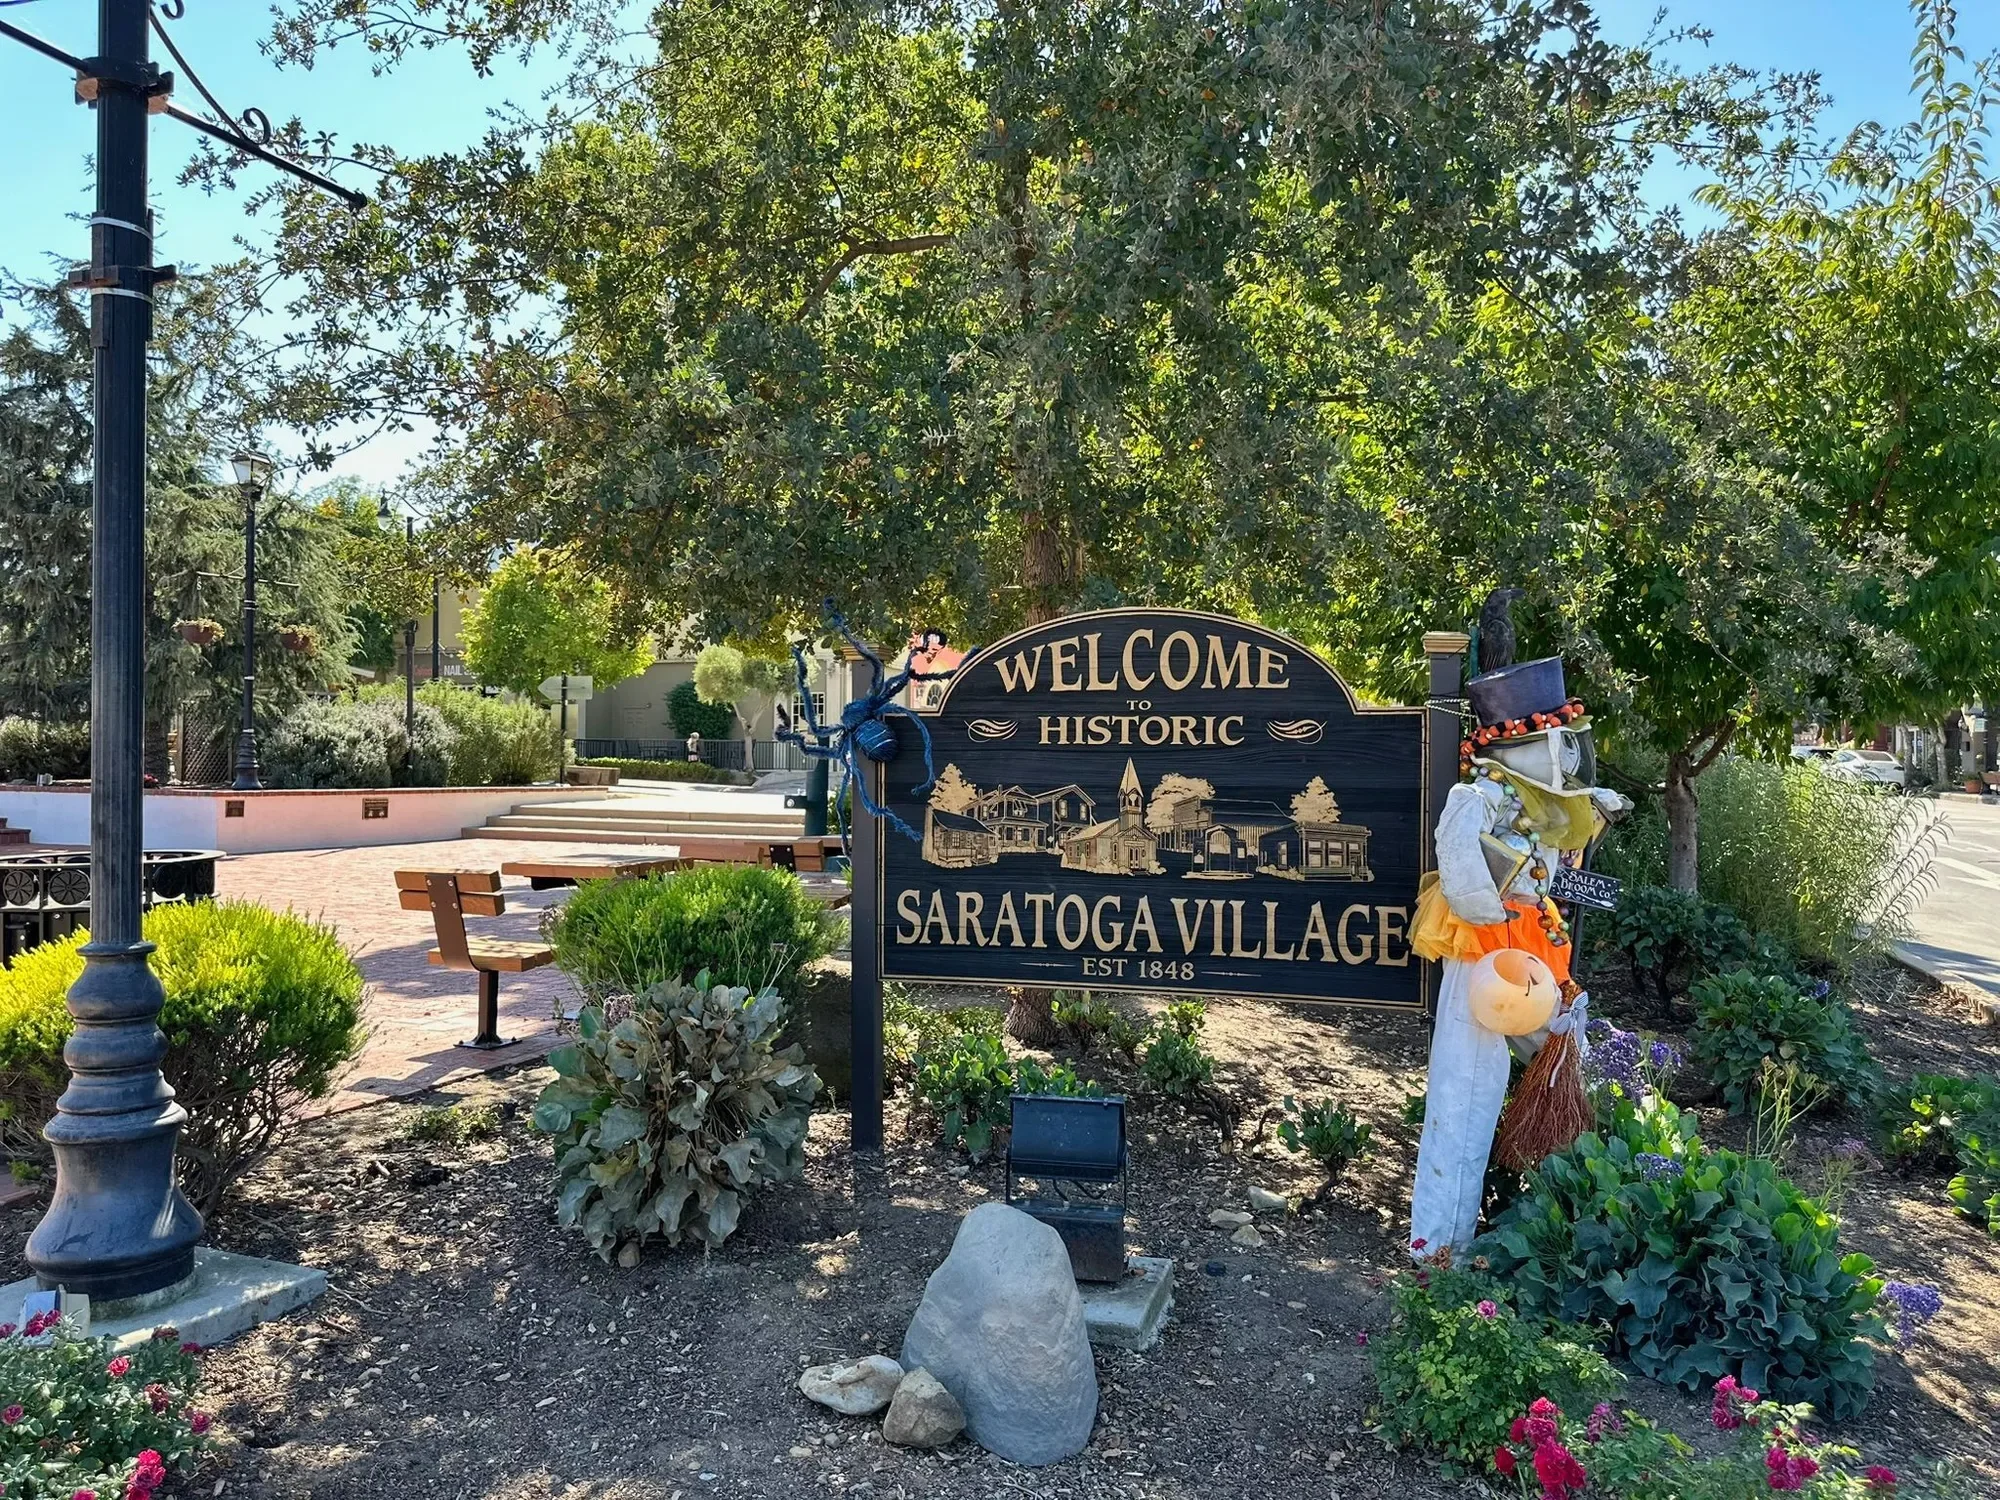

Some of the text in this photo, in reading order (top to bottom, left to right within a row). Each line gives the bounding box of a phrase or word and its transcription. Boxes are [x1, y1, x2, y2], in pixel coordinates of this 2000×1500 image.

[443, 664, 463, 676] NAIL
[993, 629, 1290, 693] WELCOME
[1126, 699, 1152, 711] TO
[1038, 715, 1245, 746] HISTORIC
[1560, 877, 1597, 897] BROOM
[1568, 870, 1606, 889] SALEM
[896, 888, 1411, 967] SARATOGA VILLAGE
[1081, 957, 1195, 981] EST 1848
